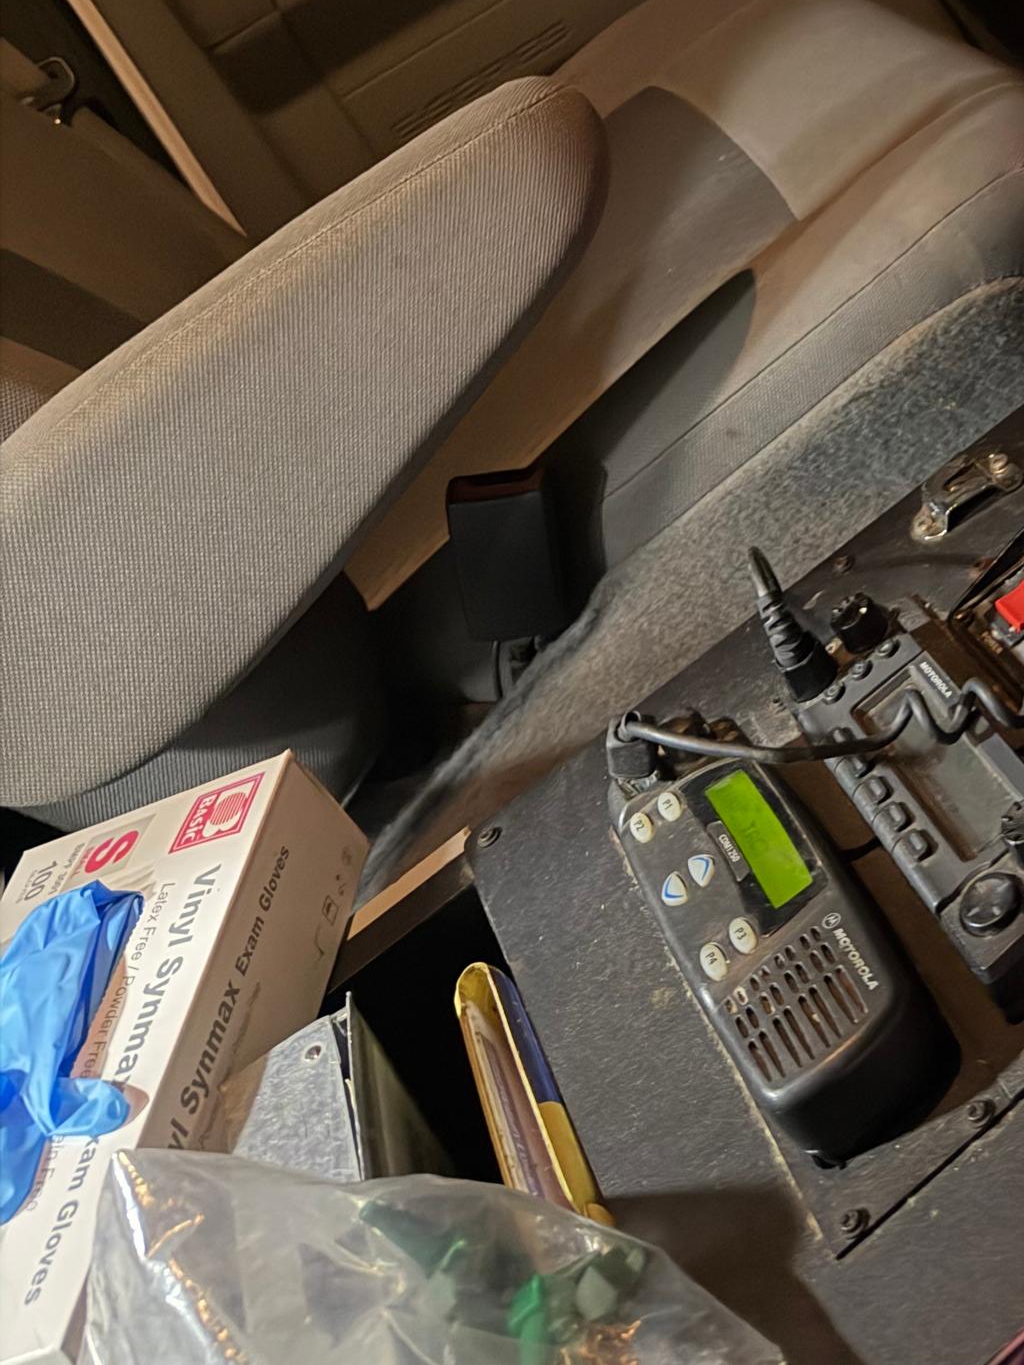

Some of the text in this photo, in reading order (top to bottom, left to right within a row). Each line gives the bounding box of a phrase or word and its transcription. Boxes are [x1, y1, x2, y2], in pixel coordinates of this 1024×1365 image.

[919, 661, 953, 699] MOTOROLA
[181, 793, 218, 845] BASIC
[662, 798, 673, 810] P1
[633, 819, 645, 832] P2
[85, 830, 139, 873] S
[24, 861, 57, 901] 100
[146, 882, 176, 923] Latex
[168, 864, 222, 948] Vinyl
[131, 926, 156, 961] Free
[734, 927, 746, 940] P3
[705, 952, 717, 966] P4
[834, 928, 879, 991] MOTOROLA
[180, 845, 290, 1115] Synmax Exam Gloves
[98, 975, 135, 1036] Powder
[24, 1200, 79, 1306] Gloves
